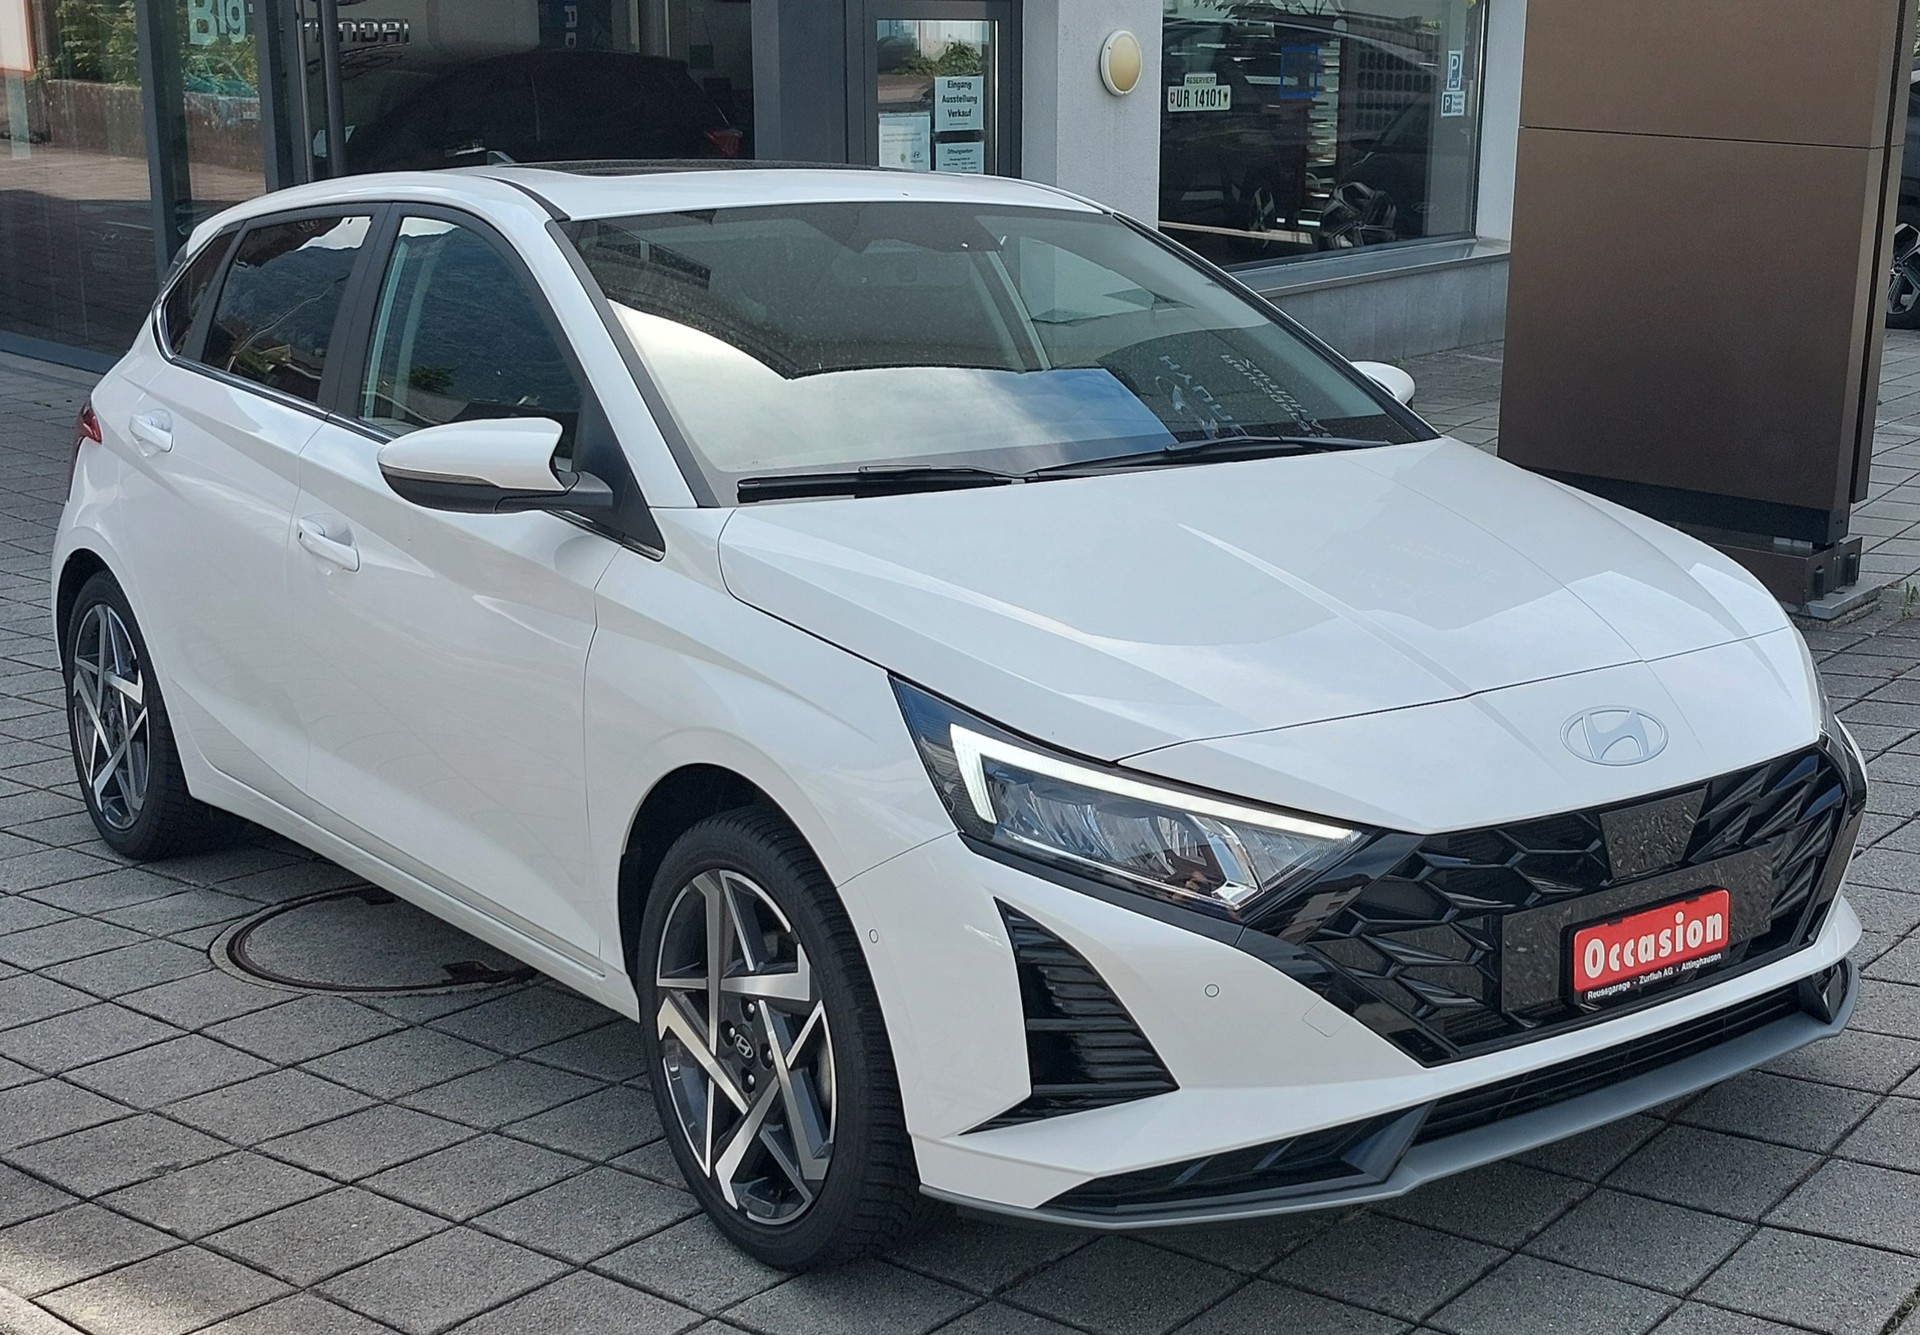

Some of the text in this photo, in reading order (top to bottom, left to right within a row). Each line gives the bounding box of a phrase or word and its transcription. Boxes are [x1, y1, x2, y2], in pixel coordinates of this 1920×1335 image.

[947, 80, 972, 91] Eingang
[1186, 76, 1216, 85] RESERVIERT
[941, 94, 978, 105] Ausstellung
[1176, 88, 1222, 108] UR 14101
[947, 108, 972, 118] Verkauf
[1584, 911, 1723, 979] Occasion
[1587, 952, 1722, 1000] Reussgarage Zurfluh AG Attinghausen
